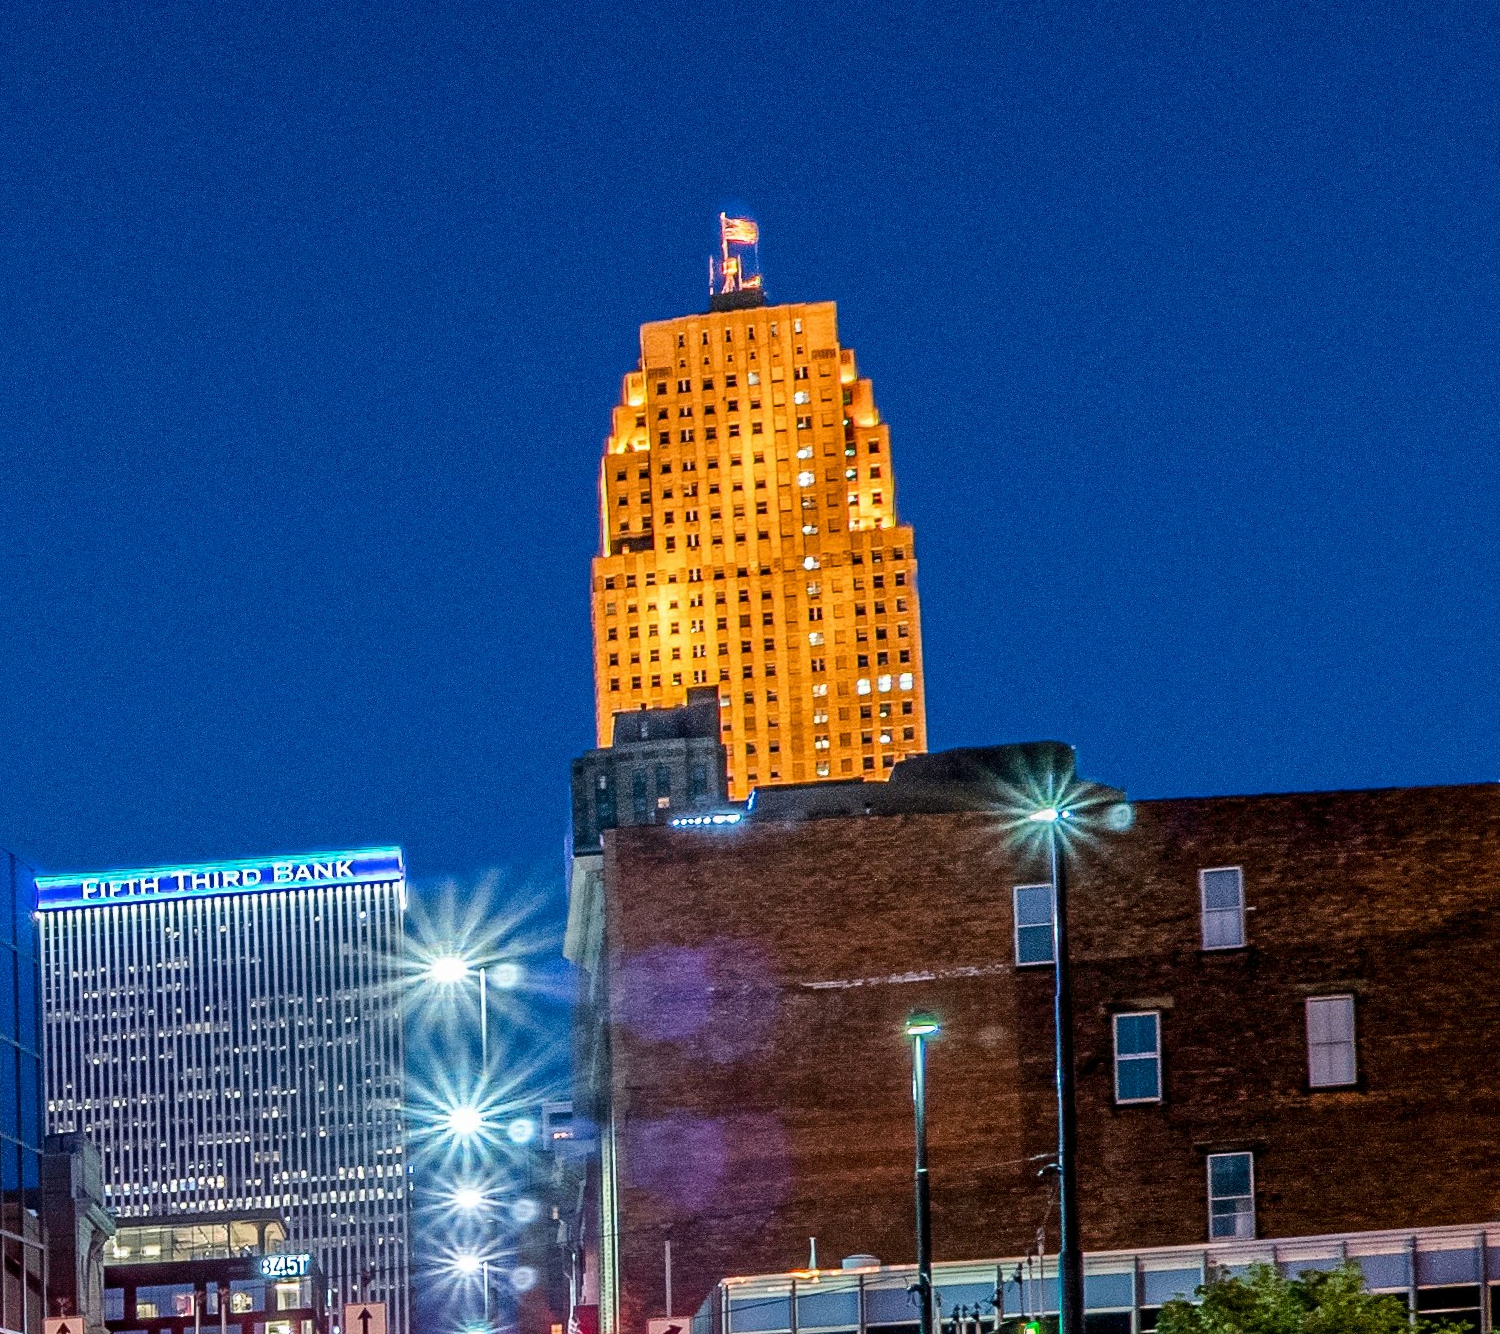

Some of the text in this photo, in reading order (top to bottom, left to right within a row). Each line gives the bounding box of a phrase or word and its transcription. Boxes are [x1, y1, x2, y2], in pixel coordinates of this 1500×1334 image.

[81, 860, 355, 900] FIFTH THIRD BANK
